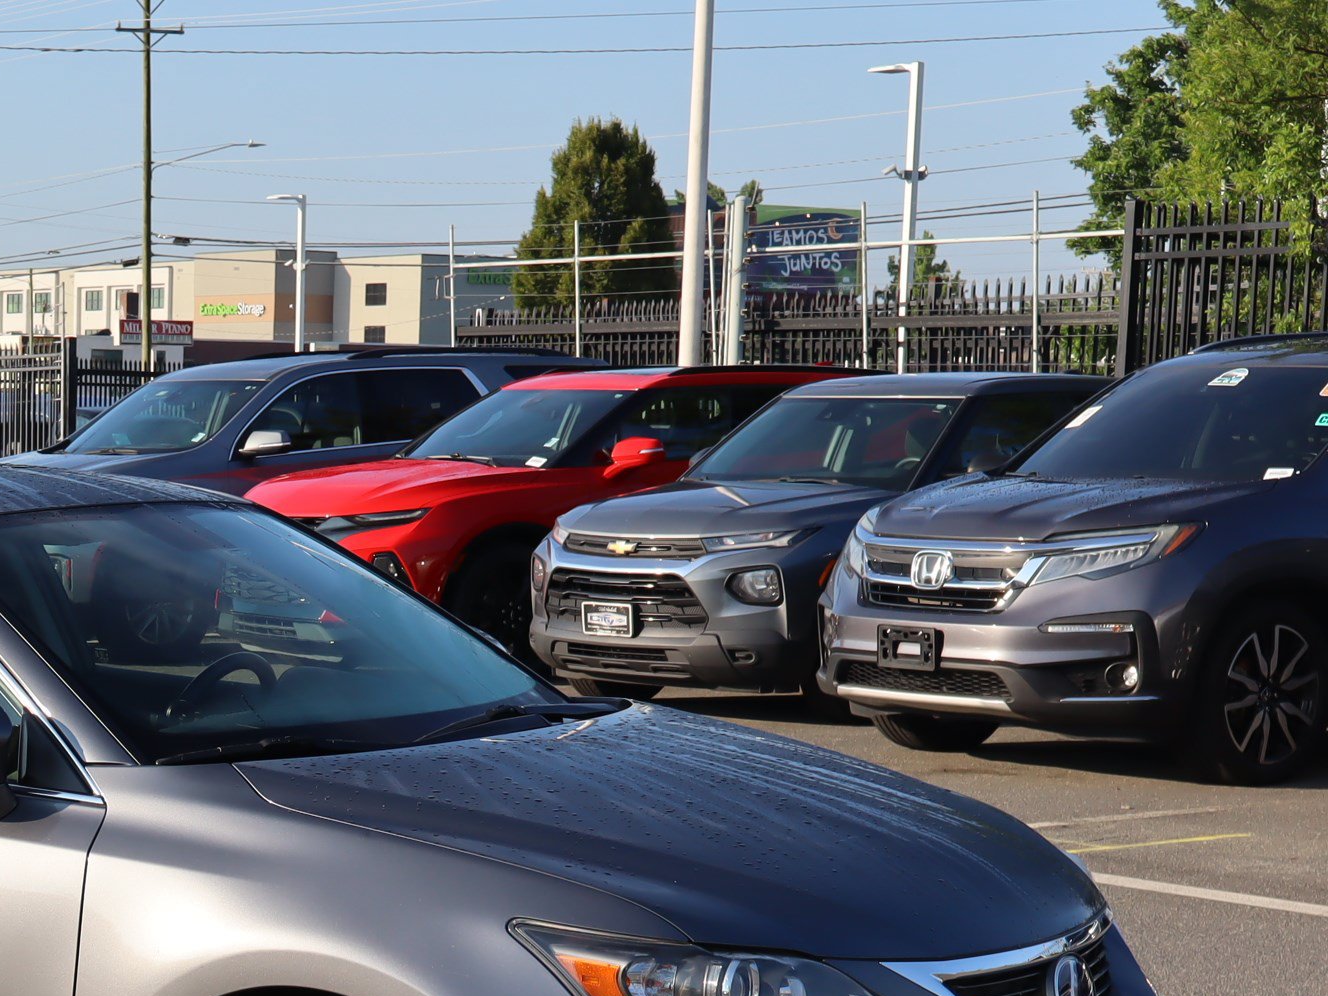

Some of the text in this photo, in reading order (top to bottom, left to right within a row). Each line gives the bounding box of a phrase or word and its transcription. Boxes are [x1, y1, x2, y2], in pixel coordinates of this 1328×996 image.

[237, 302, 266, 317] Storage
[123, 322, 191, 335] MILR PIANO
